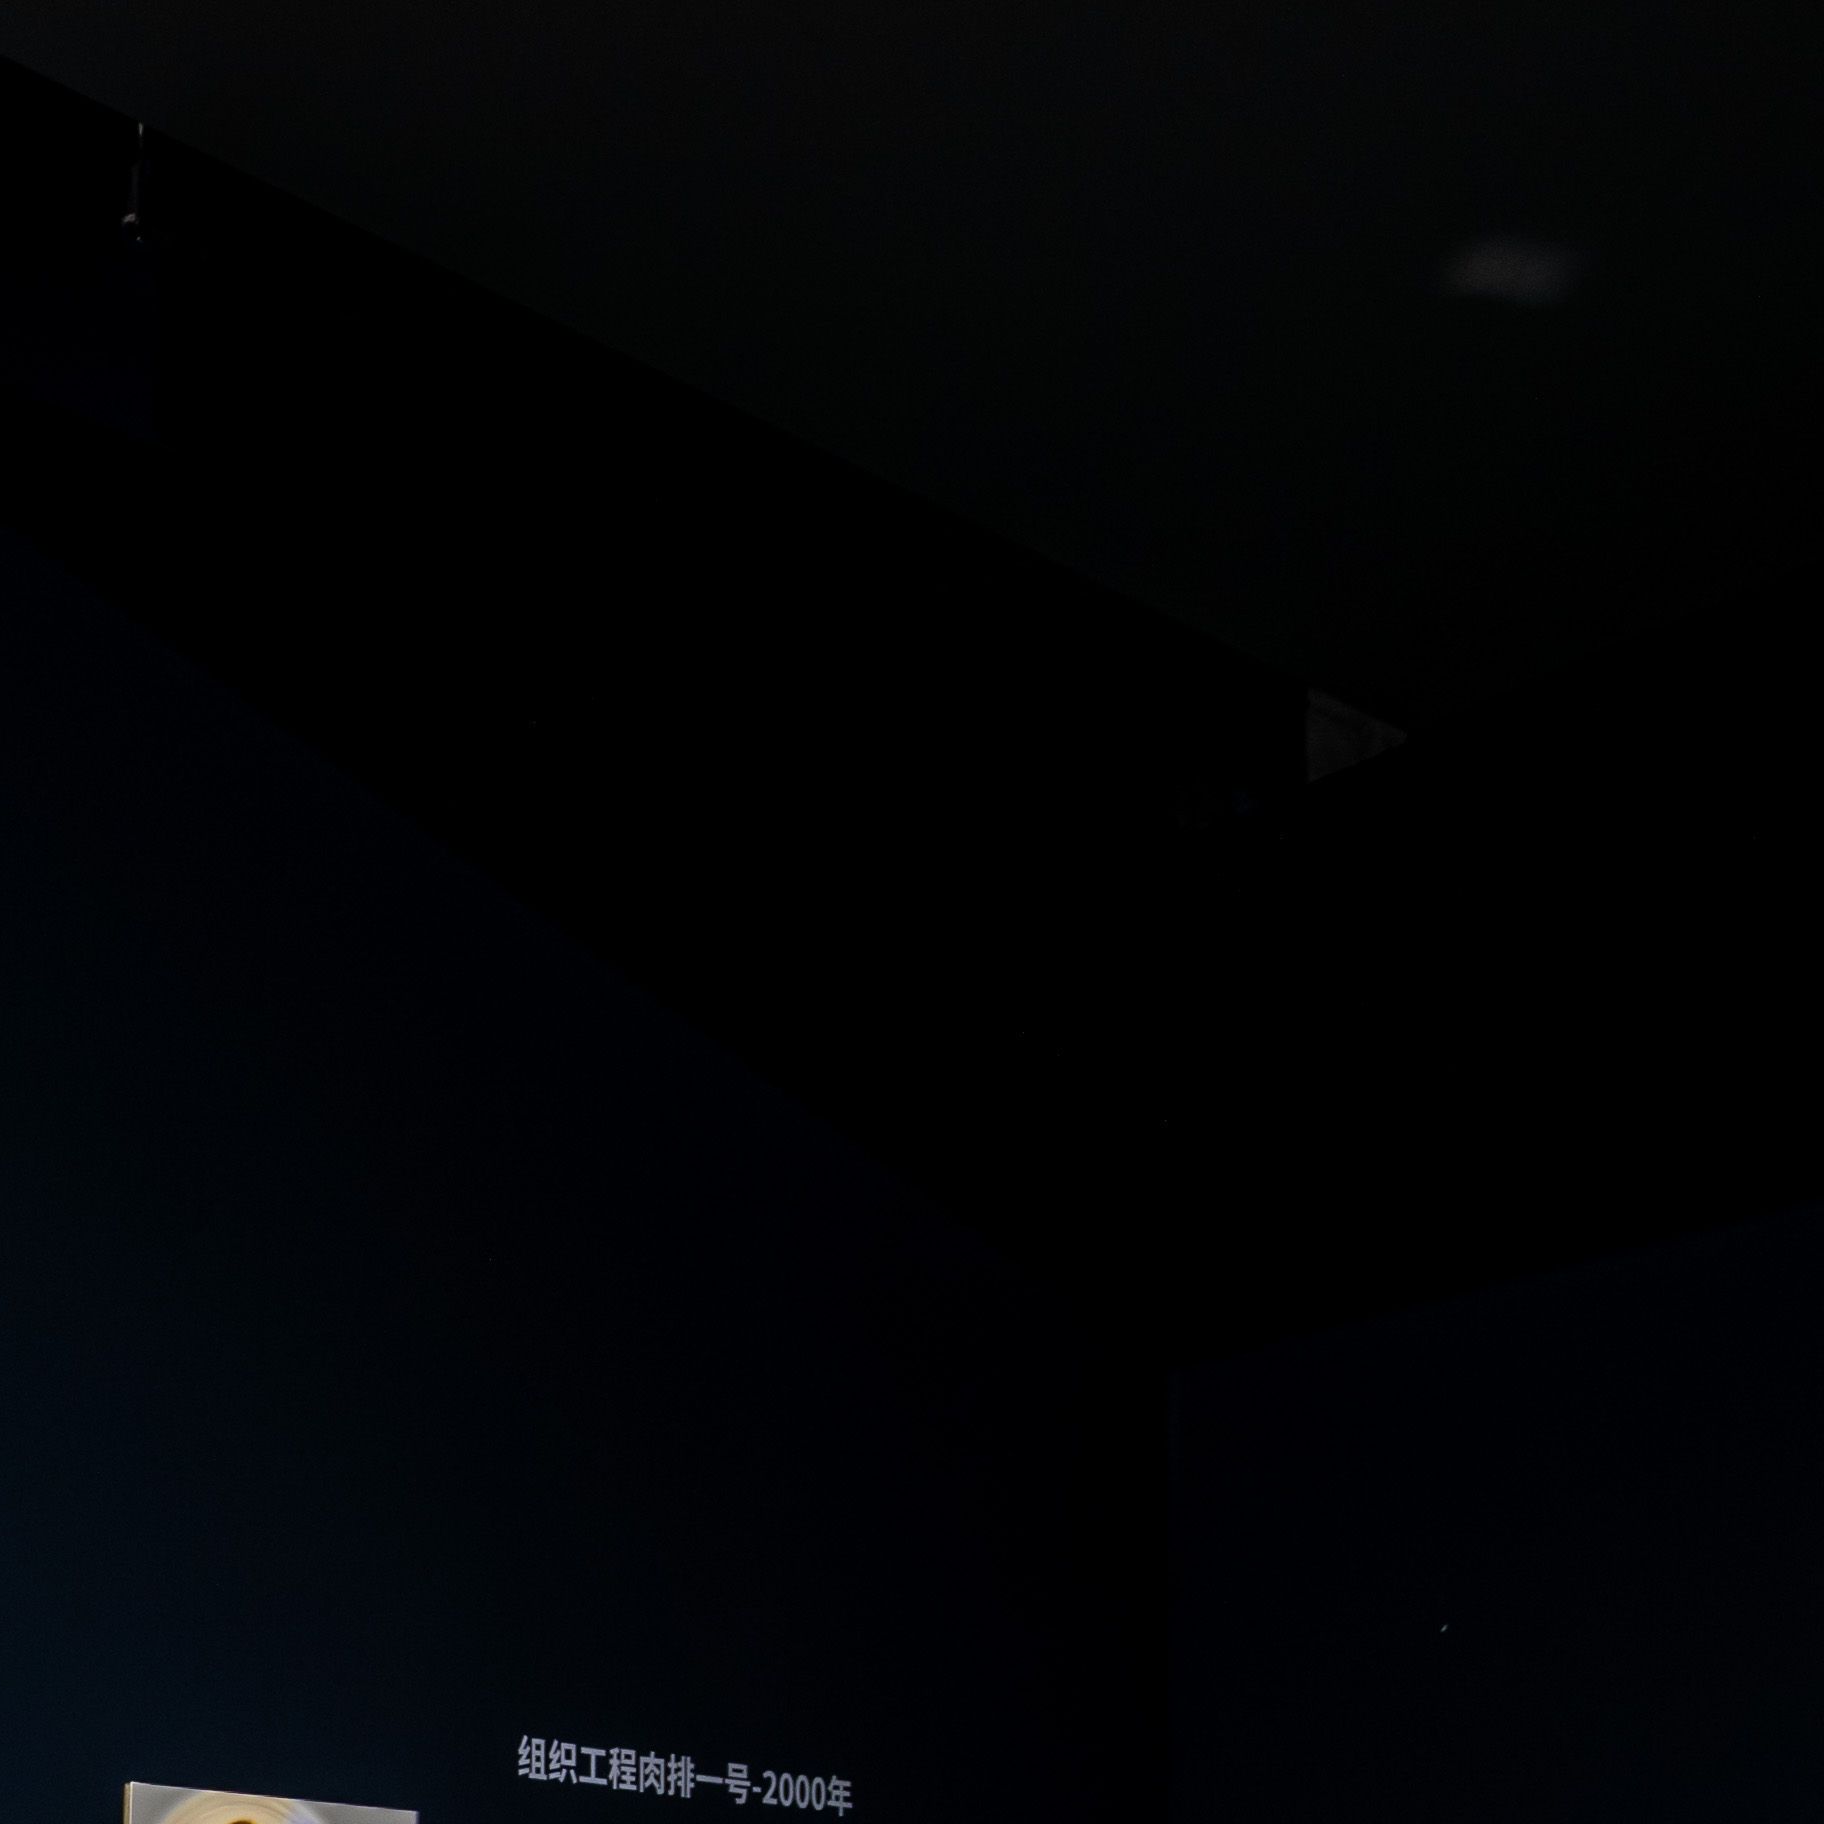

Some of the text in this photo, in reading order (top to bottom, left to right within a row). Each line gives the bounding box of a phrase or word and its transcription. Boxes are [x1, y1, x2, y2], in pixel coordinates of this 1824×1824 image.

[517, 1734, 854, 1817] 组织工程肉排一号-2000年
